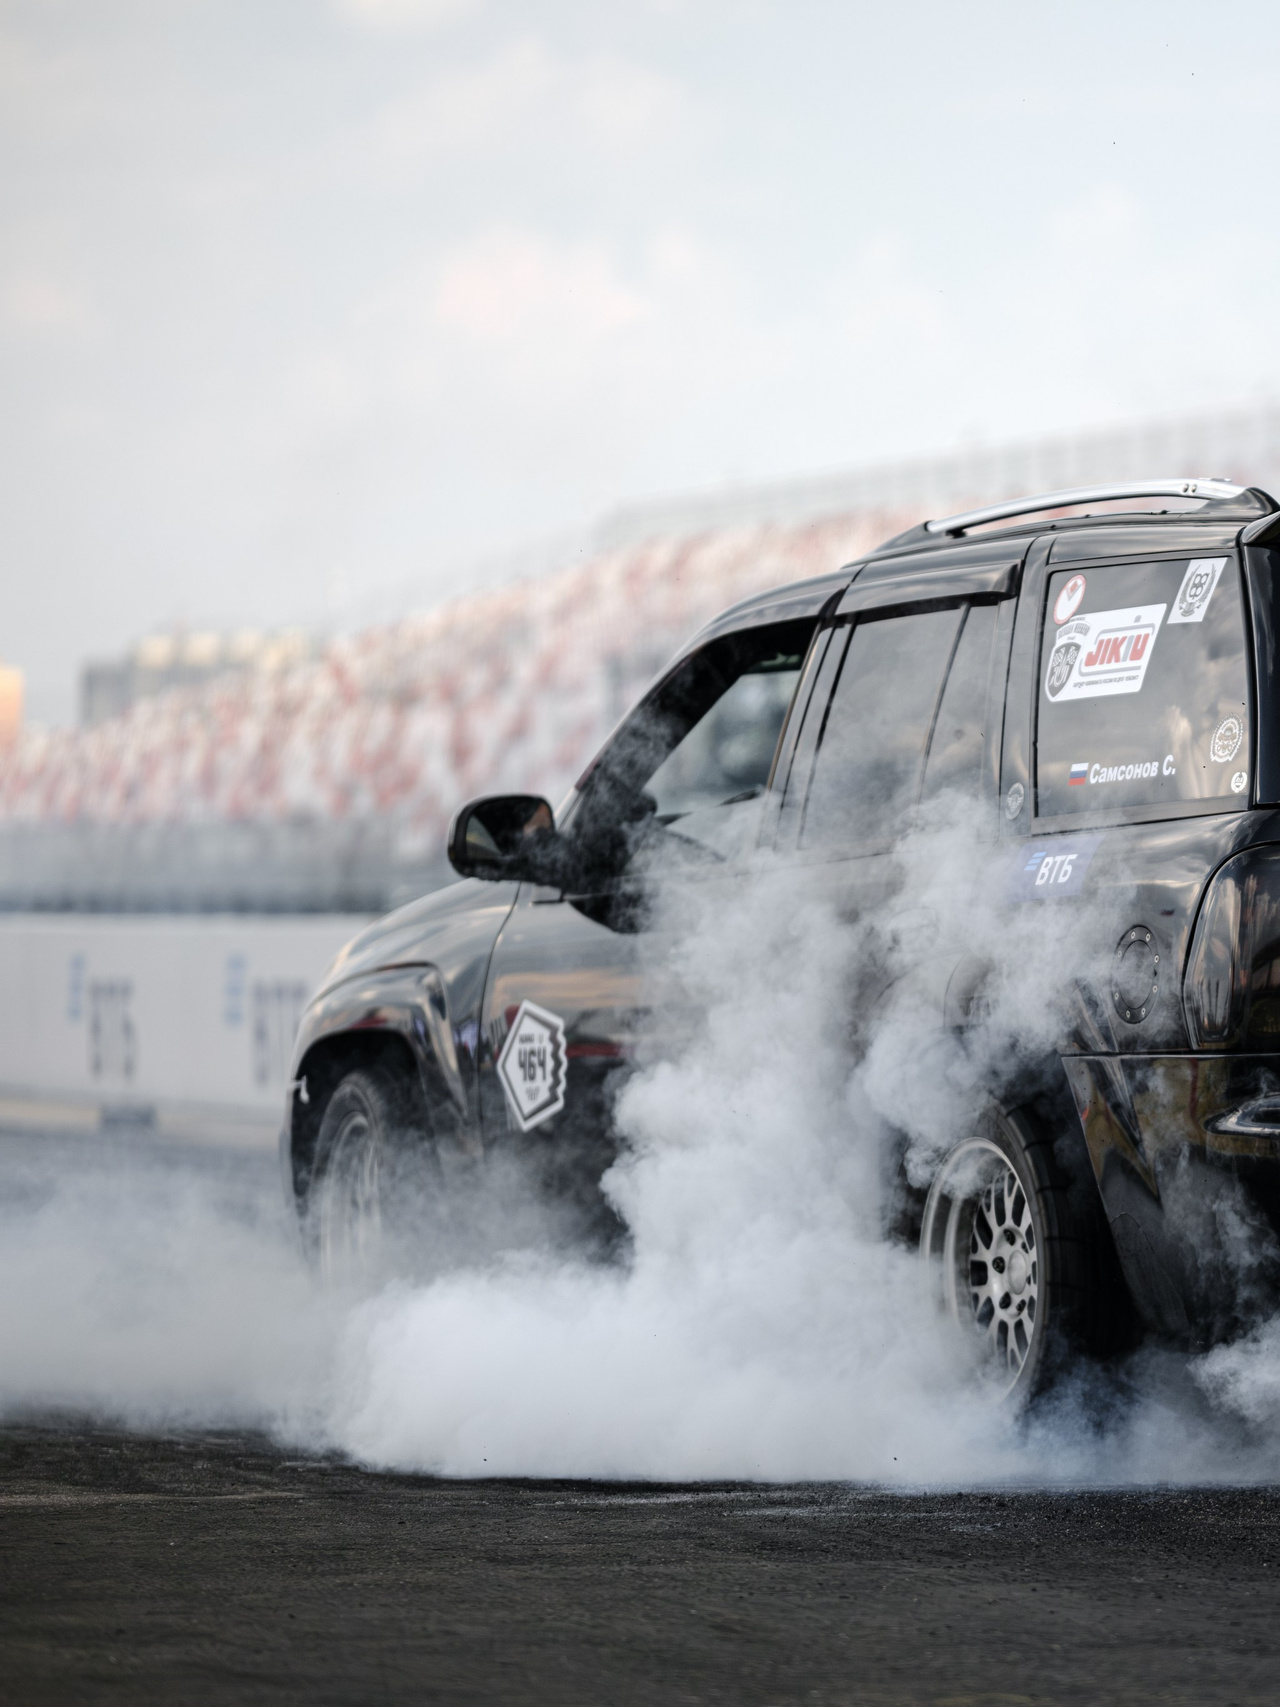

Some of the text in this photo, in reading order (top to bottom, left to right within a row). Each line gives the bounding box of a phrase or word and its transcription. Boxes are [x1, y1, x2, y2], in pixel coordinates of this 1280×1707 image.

[1084, 633, 1150, 667] JIKIU
[1089, 754, 1176, 785] Самсонов С.
[1035, 853, 1078, 886] ВТБ
[518, 1046, 547, 1082] 464
